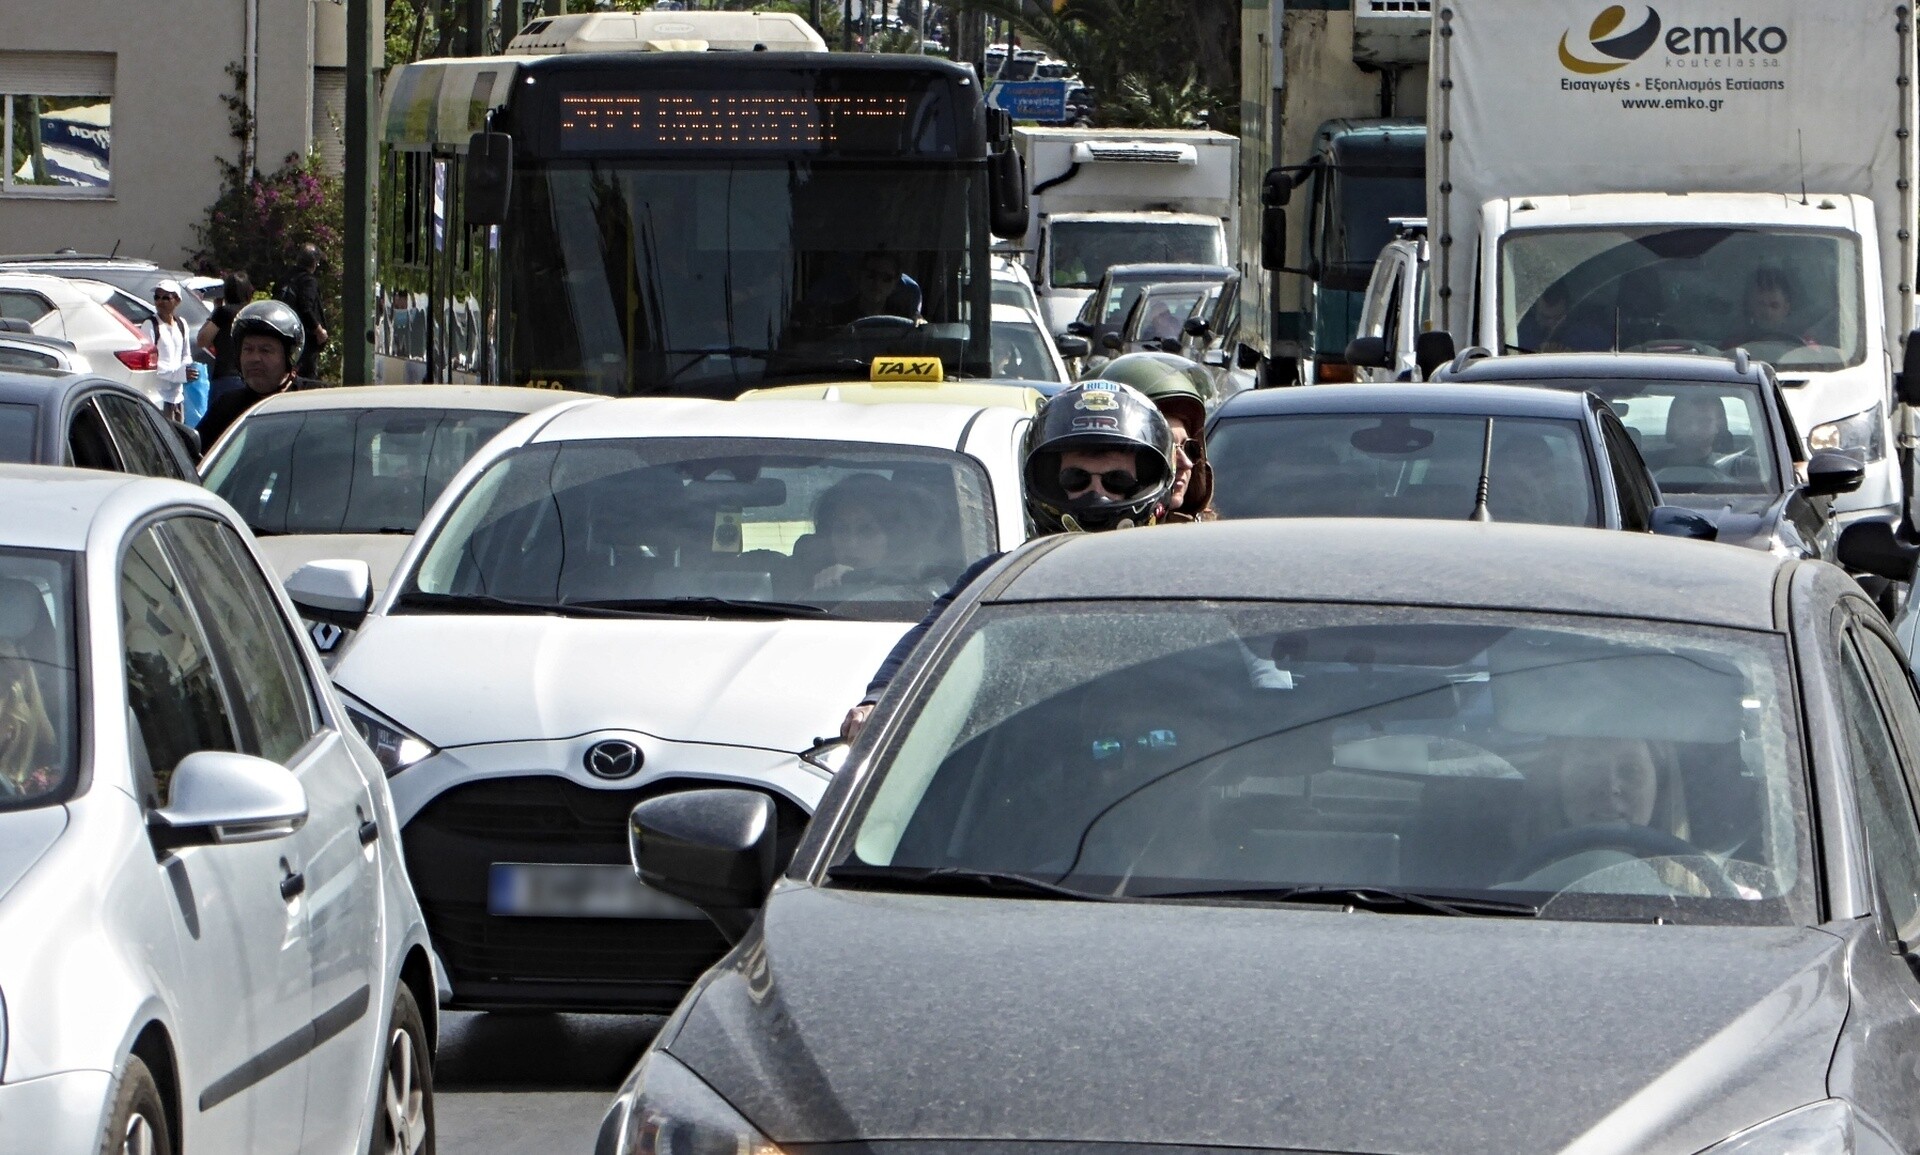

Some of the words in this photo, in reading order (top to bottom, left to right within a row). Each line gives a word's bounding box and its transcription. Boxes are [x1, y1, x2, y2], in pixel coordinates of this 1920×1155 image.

[1665, 17, 1788, 56] emko
[1665, 57, 1756, 68] koutelas
[1560, 78, 1631, 93] Εισαγωγές
[1621, 96, 1725, 112] www.emko.gr
[877, 362, 935, 375] TAXI
